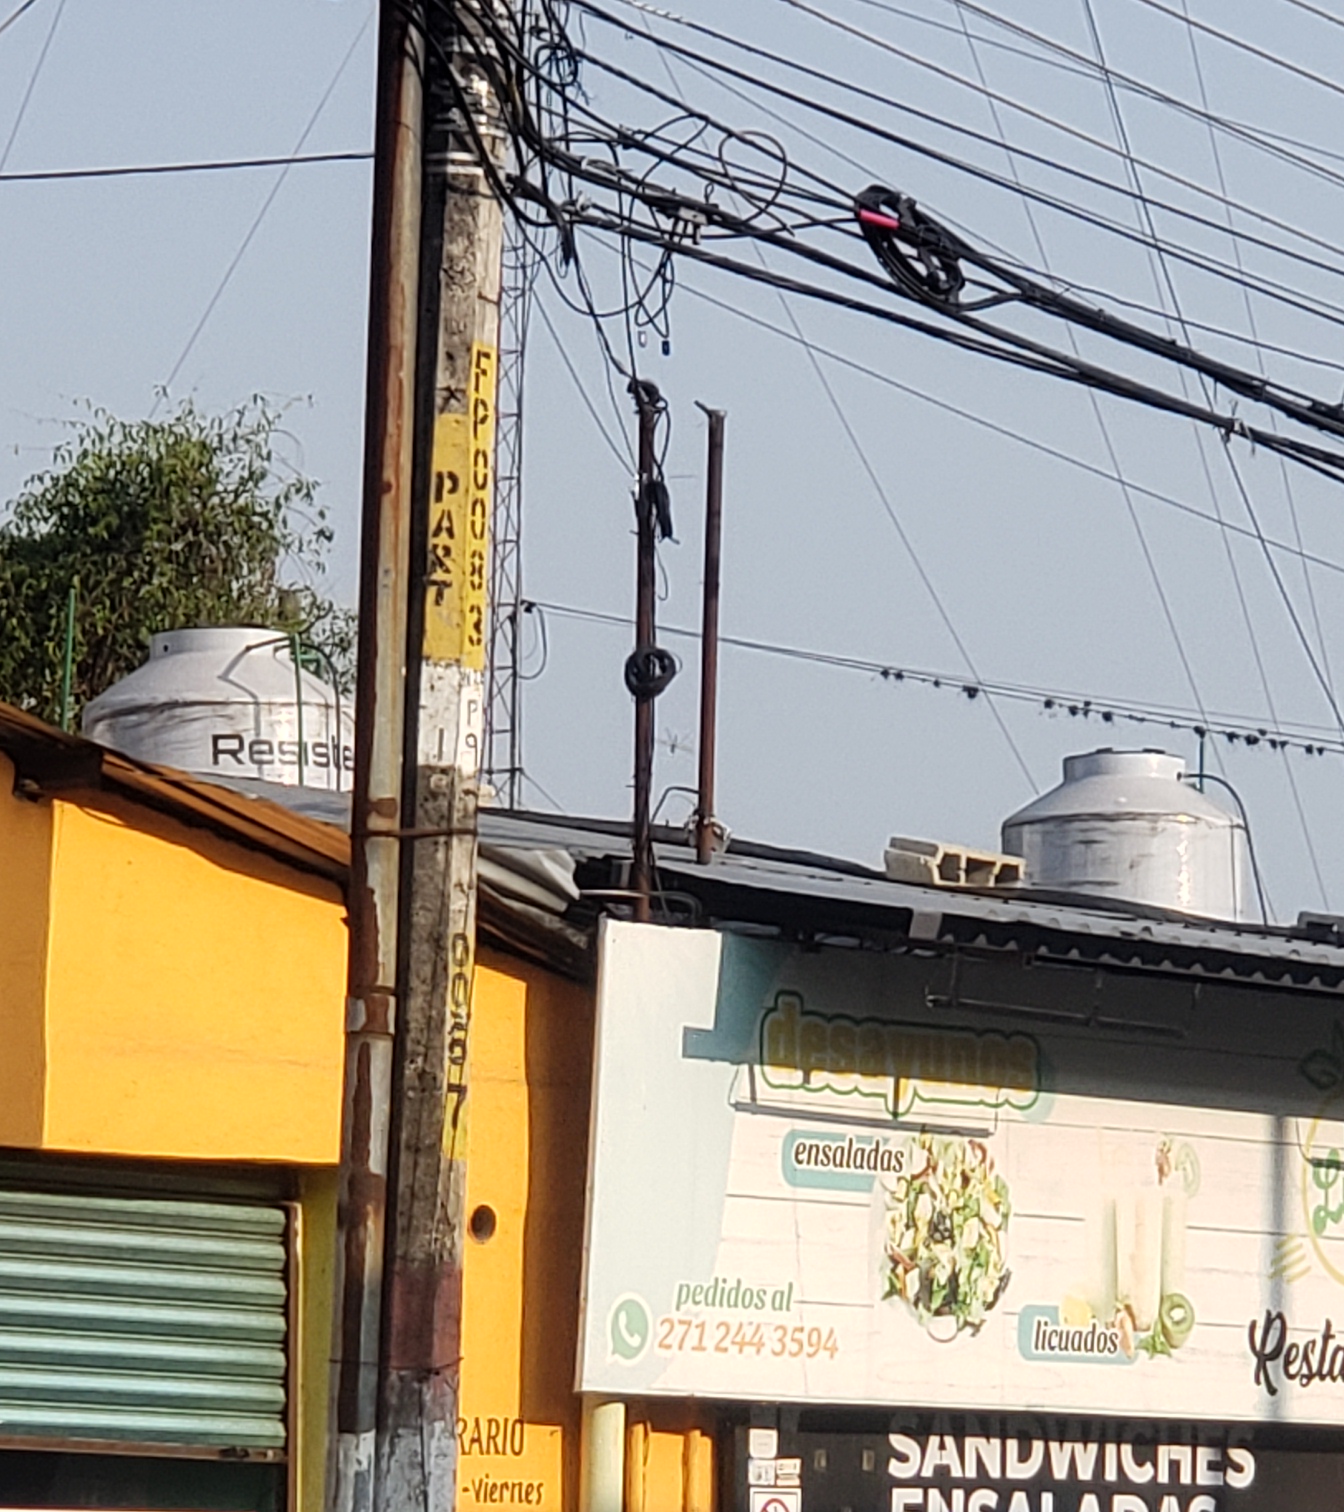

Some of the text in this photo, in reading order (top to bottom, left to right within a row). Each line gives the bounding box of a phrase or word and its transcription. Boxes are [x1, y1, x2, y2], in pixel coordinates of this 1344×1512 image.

[794, 1138, 905, 1173] ensaladas
[675, 1277, 794, 1312] pedidos al
[658, 1317, 839, 1360] 271 244 3594
[1034, 1321, 1119, 1355] licuados
[456, 1417, 526, 1456] RARIO
[887, 1413, 1256, 1489] SANDWICHES
